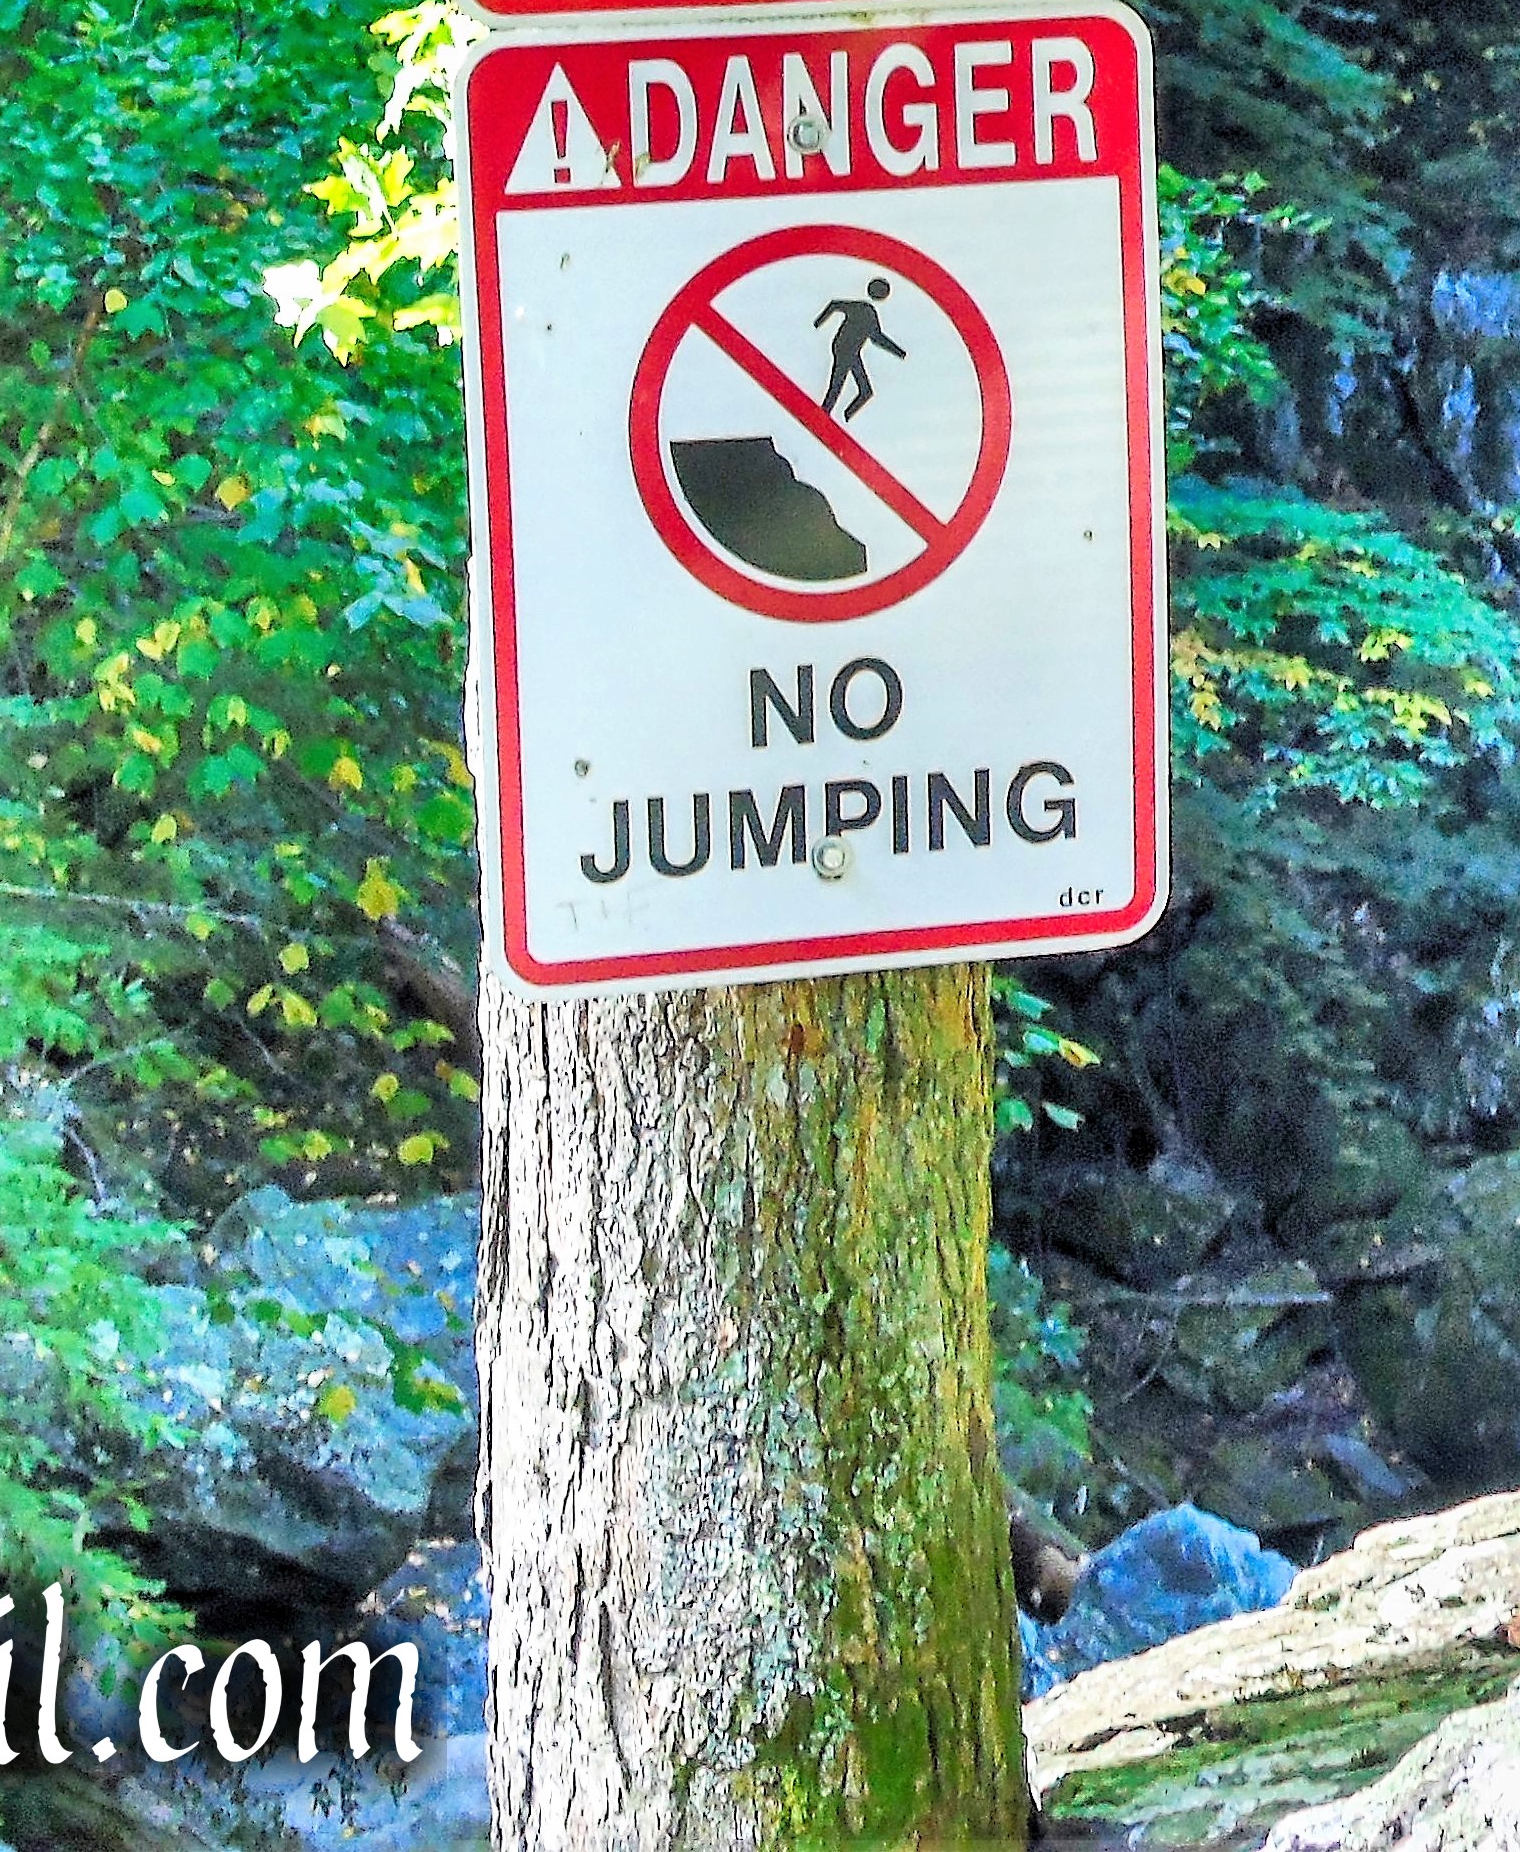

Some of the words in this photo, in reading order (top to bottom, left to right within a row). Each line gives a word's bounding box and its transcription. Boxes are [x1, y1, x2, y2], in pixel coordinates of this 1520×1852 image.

[628, 36, 1097, 188] DANGER
[749, 656, 904, 748] NO
[580, 760, 1077, 884] JUMPING
[1059, 886, 1104, 908] dcr
